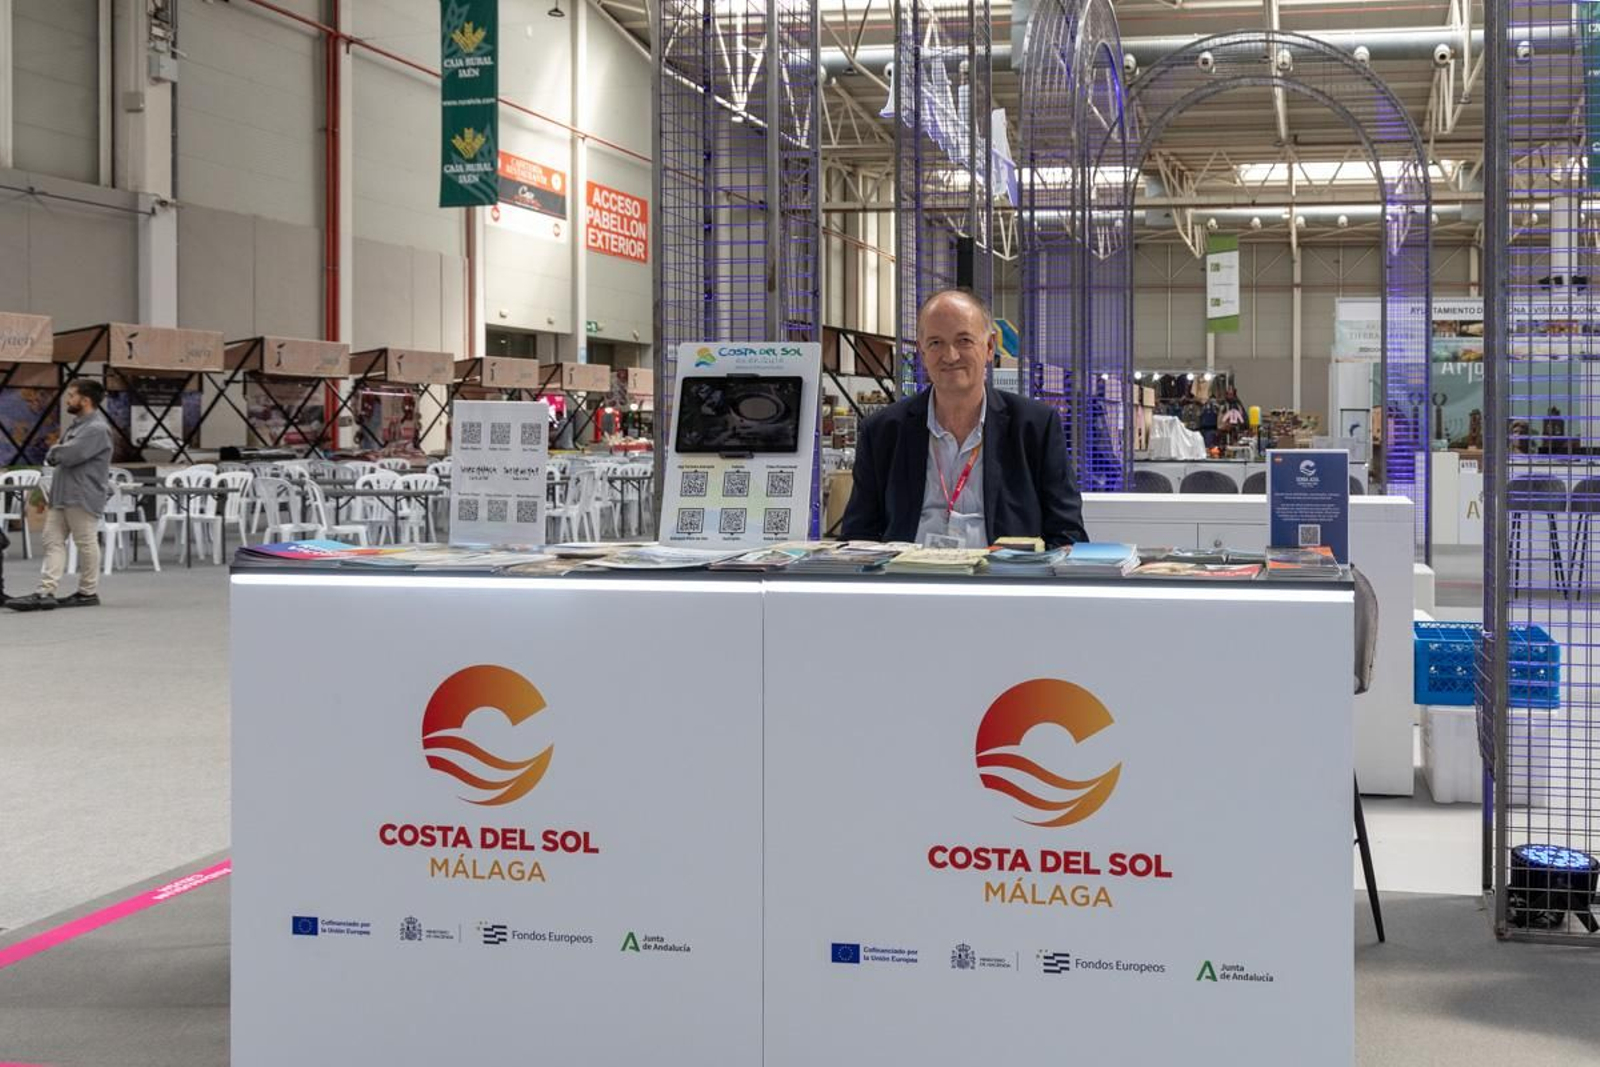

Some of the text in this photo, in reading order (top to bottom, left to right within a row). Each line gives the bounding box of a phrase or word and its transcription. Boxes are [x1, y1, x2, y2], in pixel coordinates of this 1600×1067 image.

[443, 56, 494, 67] CAJA RURAL
[443, 162, 494, 173] CAJA RURAL
[593, 187, 641, 218] ACCESO
[587, 205, 646, 240] PABELLON
[588, 226, 645, 259] EXTERIOR
[781, 347, 803, 357] SOL
[379, 823, 599, 854] COSTA DEL SOL
[927, 845, 1172, 878] COSTA DEL SOL
[429, 854, 546, 882] MÁLAGA
[984, 878, 1113, 907] MÁLAGA
[321, 919, 359, 927] Cofinanciado
[512, 930, 593, 945] Fondos Europeos
[643, 934, 665, 943] Junta
[653, 943, 691, 952] Andalucía
[863, 946, 906, 954] Cofinanciado
[891, 955, 918, 963] Europea
[1075, 958, 1165, 973] Fondos Europeos
[1221, 963, 1244, 972] Junta
[1220, 971, 1274, 982] de Andalucía
